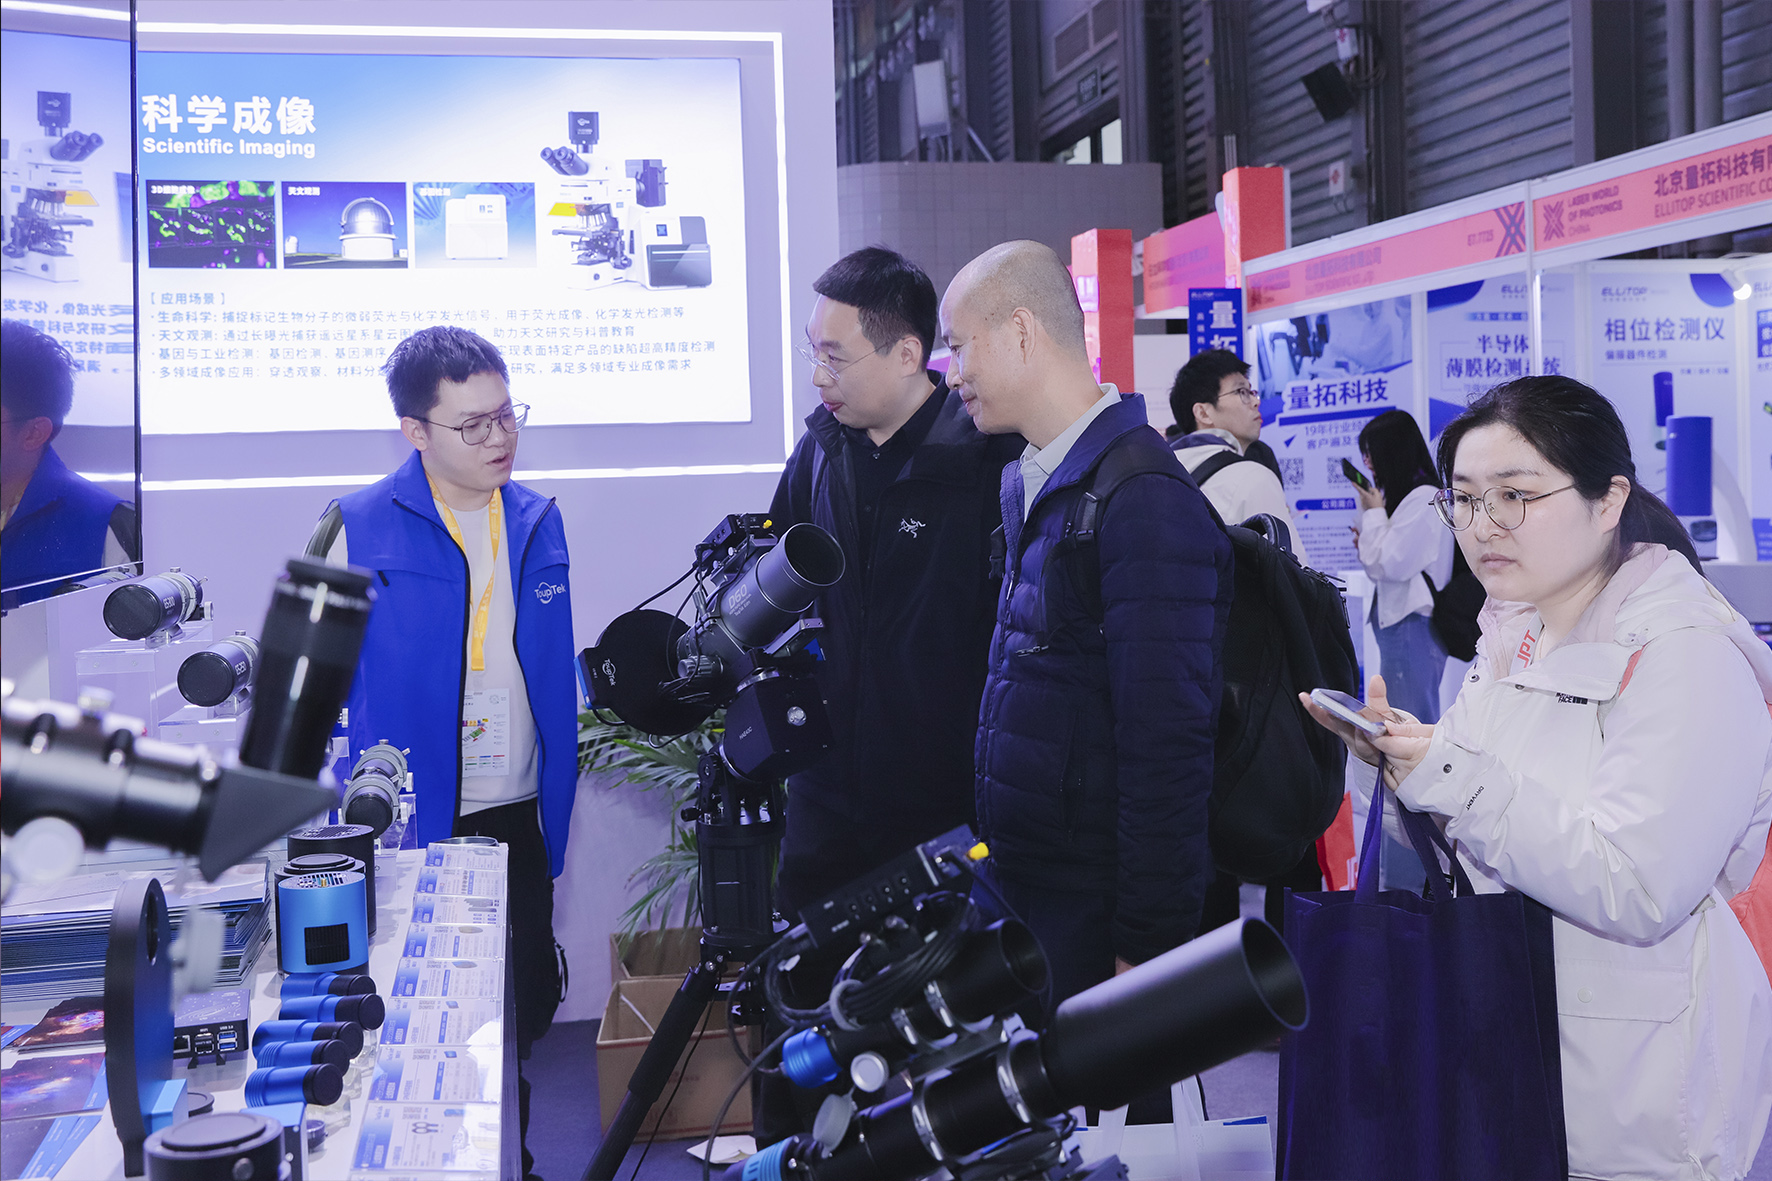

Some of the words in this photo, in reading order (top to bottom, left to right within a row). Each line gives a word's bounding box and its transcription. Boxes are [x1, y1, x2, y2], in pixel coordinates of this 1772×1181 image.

[141, 94, 317, 135] 科学成像
[142, 137, 234, 155] Scientific
[239, 139, 316, 159] Imaging
[1698, 181, 1757, 208] SCIENTIFIC
[1605, 317, 1726, 343] 相位检测仪
[1476, 334, 1529, 354] 半导体
[1446, 357, 1561, 378] 薄膜检测统
[1288, 378, 1388, 411] 量拓科技
[534, 582, 567, 600] ToupTek
[729, 583, 748, 609] D60
[1516, 629, 1536, 669] JPT
